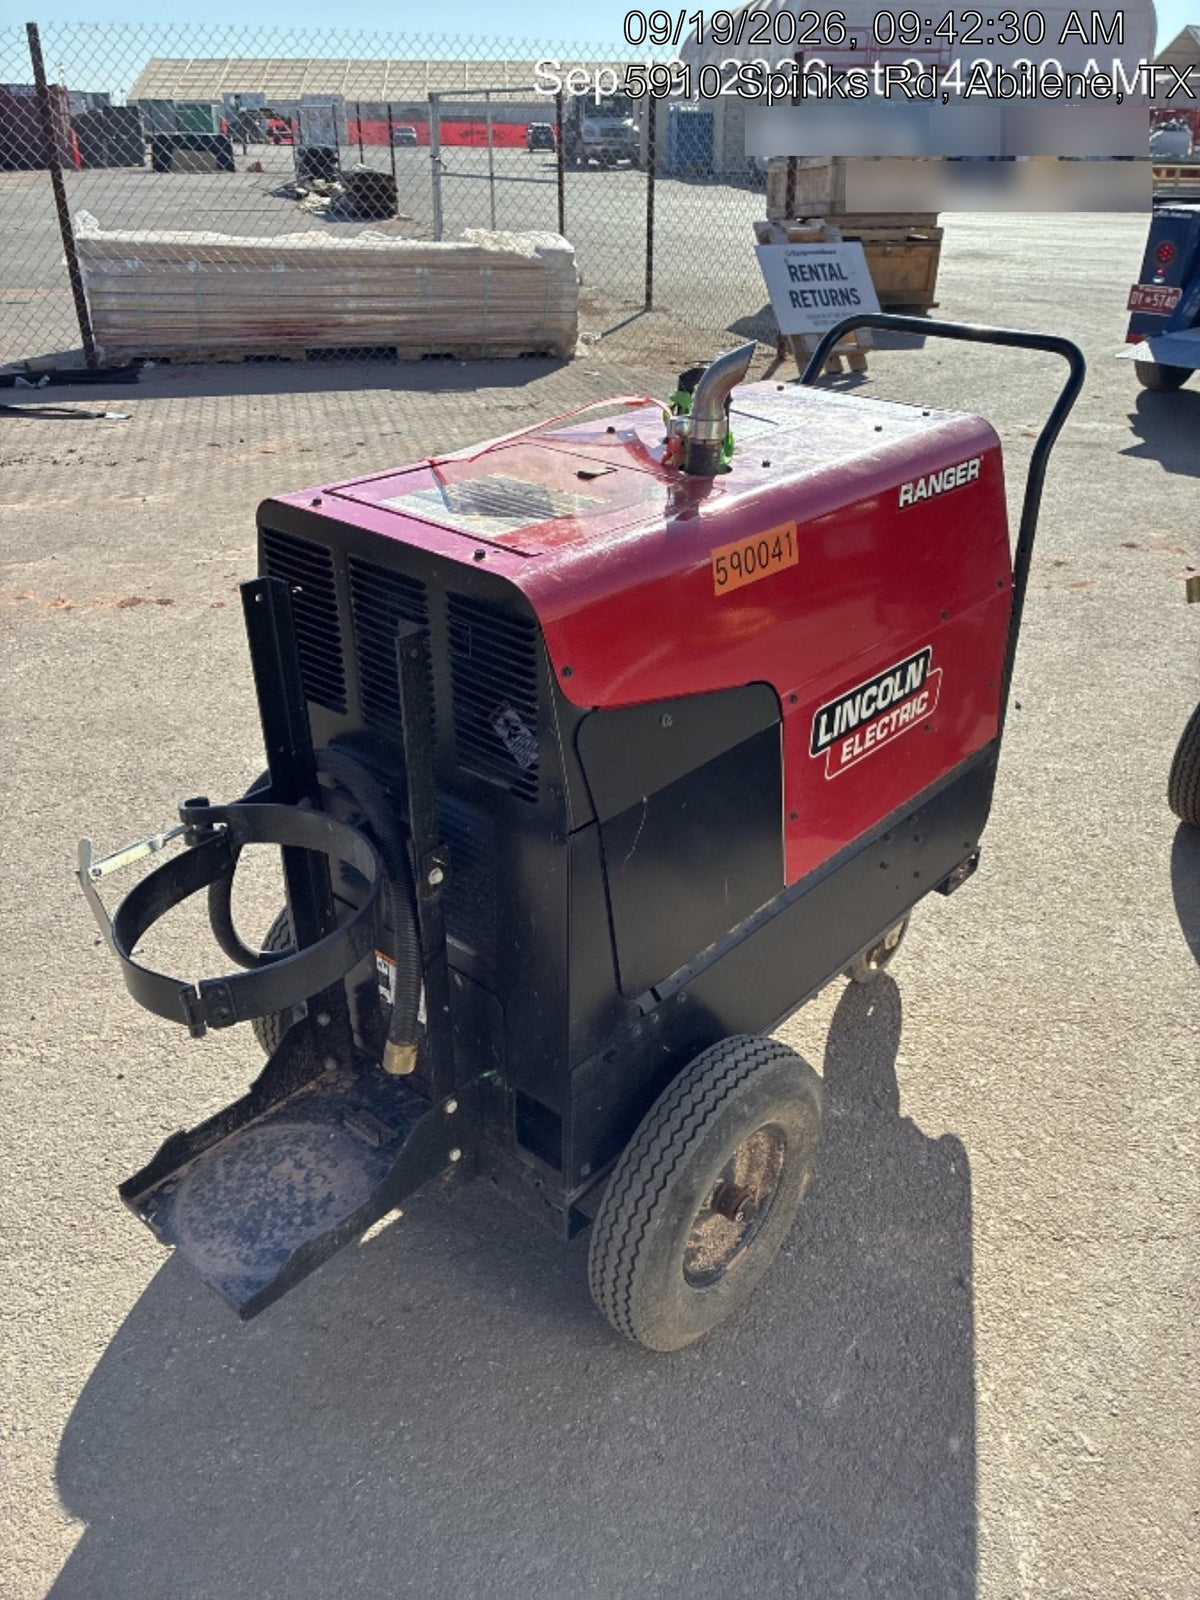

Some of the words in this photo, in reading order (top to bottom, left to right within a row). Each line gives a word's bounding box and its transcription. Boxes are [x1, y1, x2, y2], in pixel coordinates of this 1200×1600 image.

[787, 263, 848, 282] RENTAL
[789, 287, 861, 308] RETURNS
[899, 458, 981, 509] RANGER
[715, 531, 795, 586] 590041
[817, 657, 925, 747] LINCOLN
[840, 691, 929, 764] ELECTRIC
